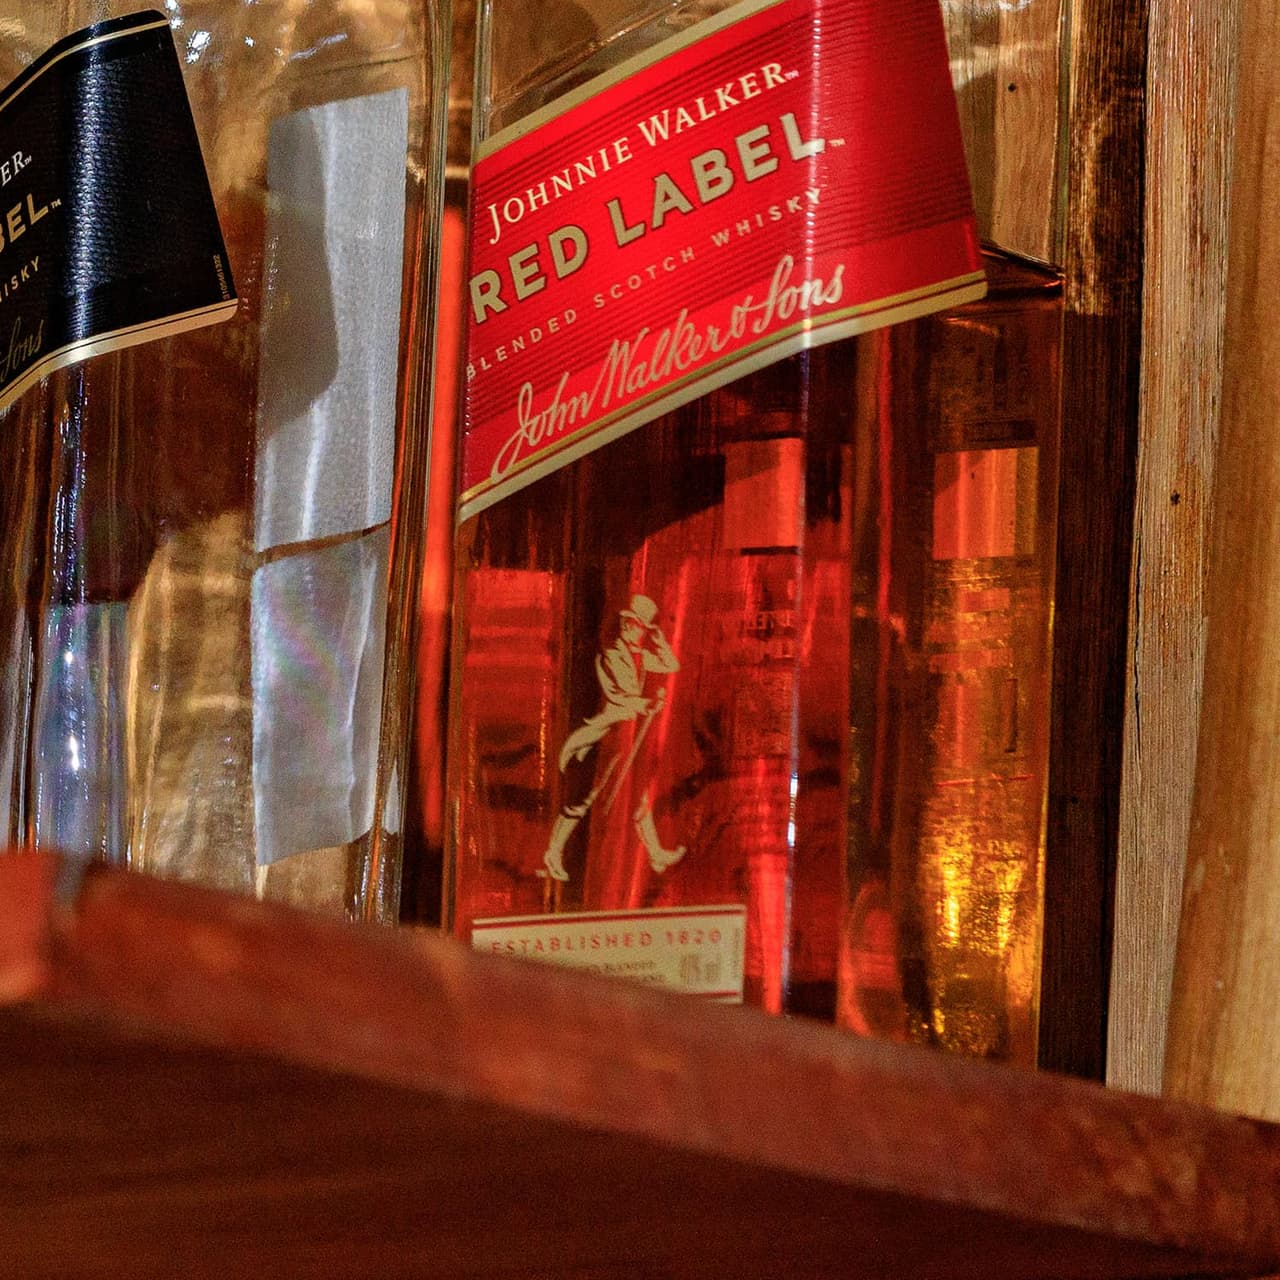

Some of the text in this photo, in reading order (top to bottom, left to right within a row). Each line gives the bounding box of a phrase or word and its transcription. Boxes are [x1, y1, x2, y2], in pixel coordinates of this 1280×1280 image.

[468, 111, 826, 325] RED LABEL
[487, 62, 787, 246] JOHNNIE WALKER
[465, 185, 823, 380] BLENDED SCOTCH WHISKY
[490, 371, 592, 485] John
[590, 308, 728, 410] Walker
[751, 254, 846, 334] Sons
[489, 927, 724, 956] ESTABLISHED 1820
